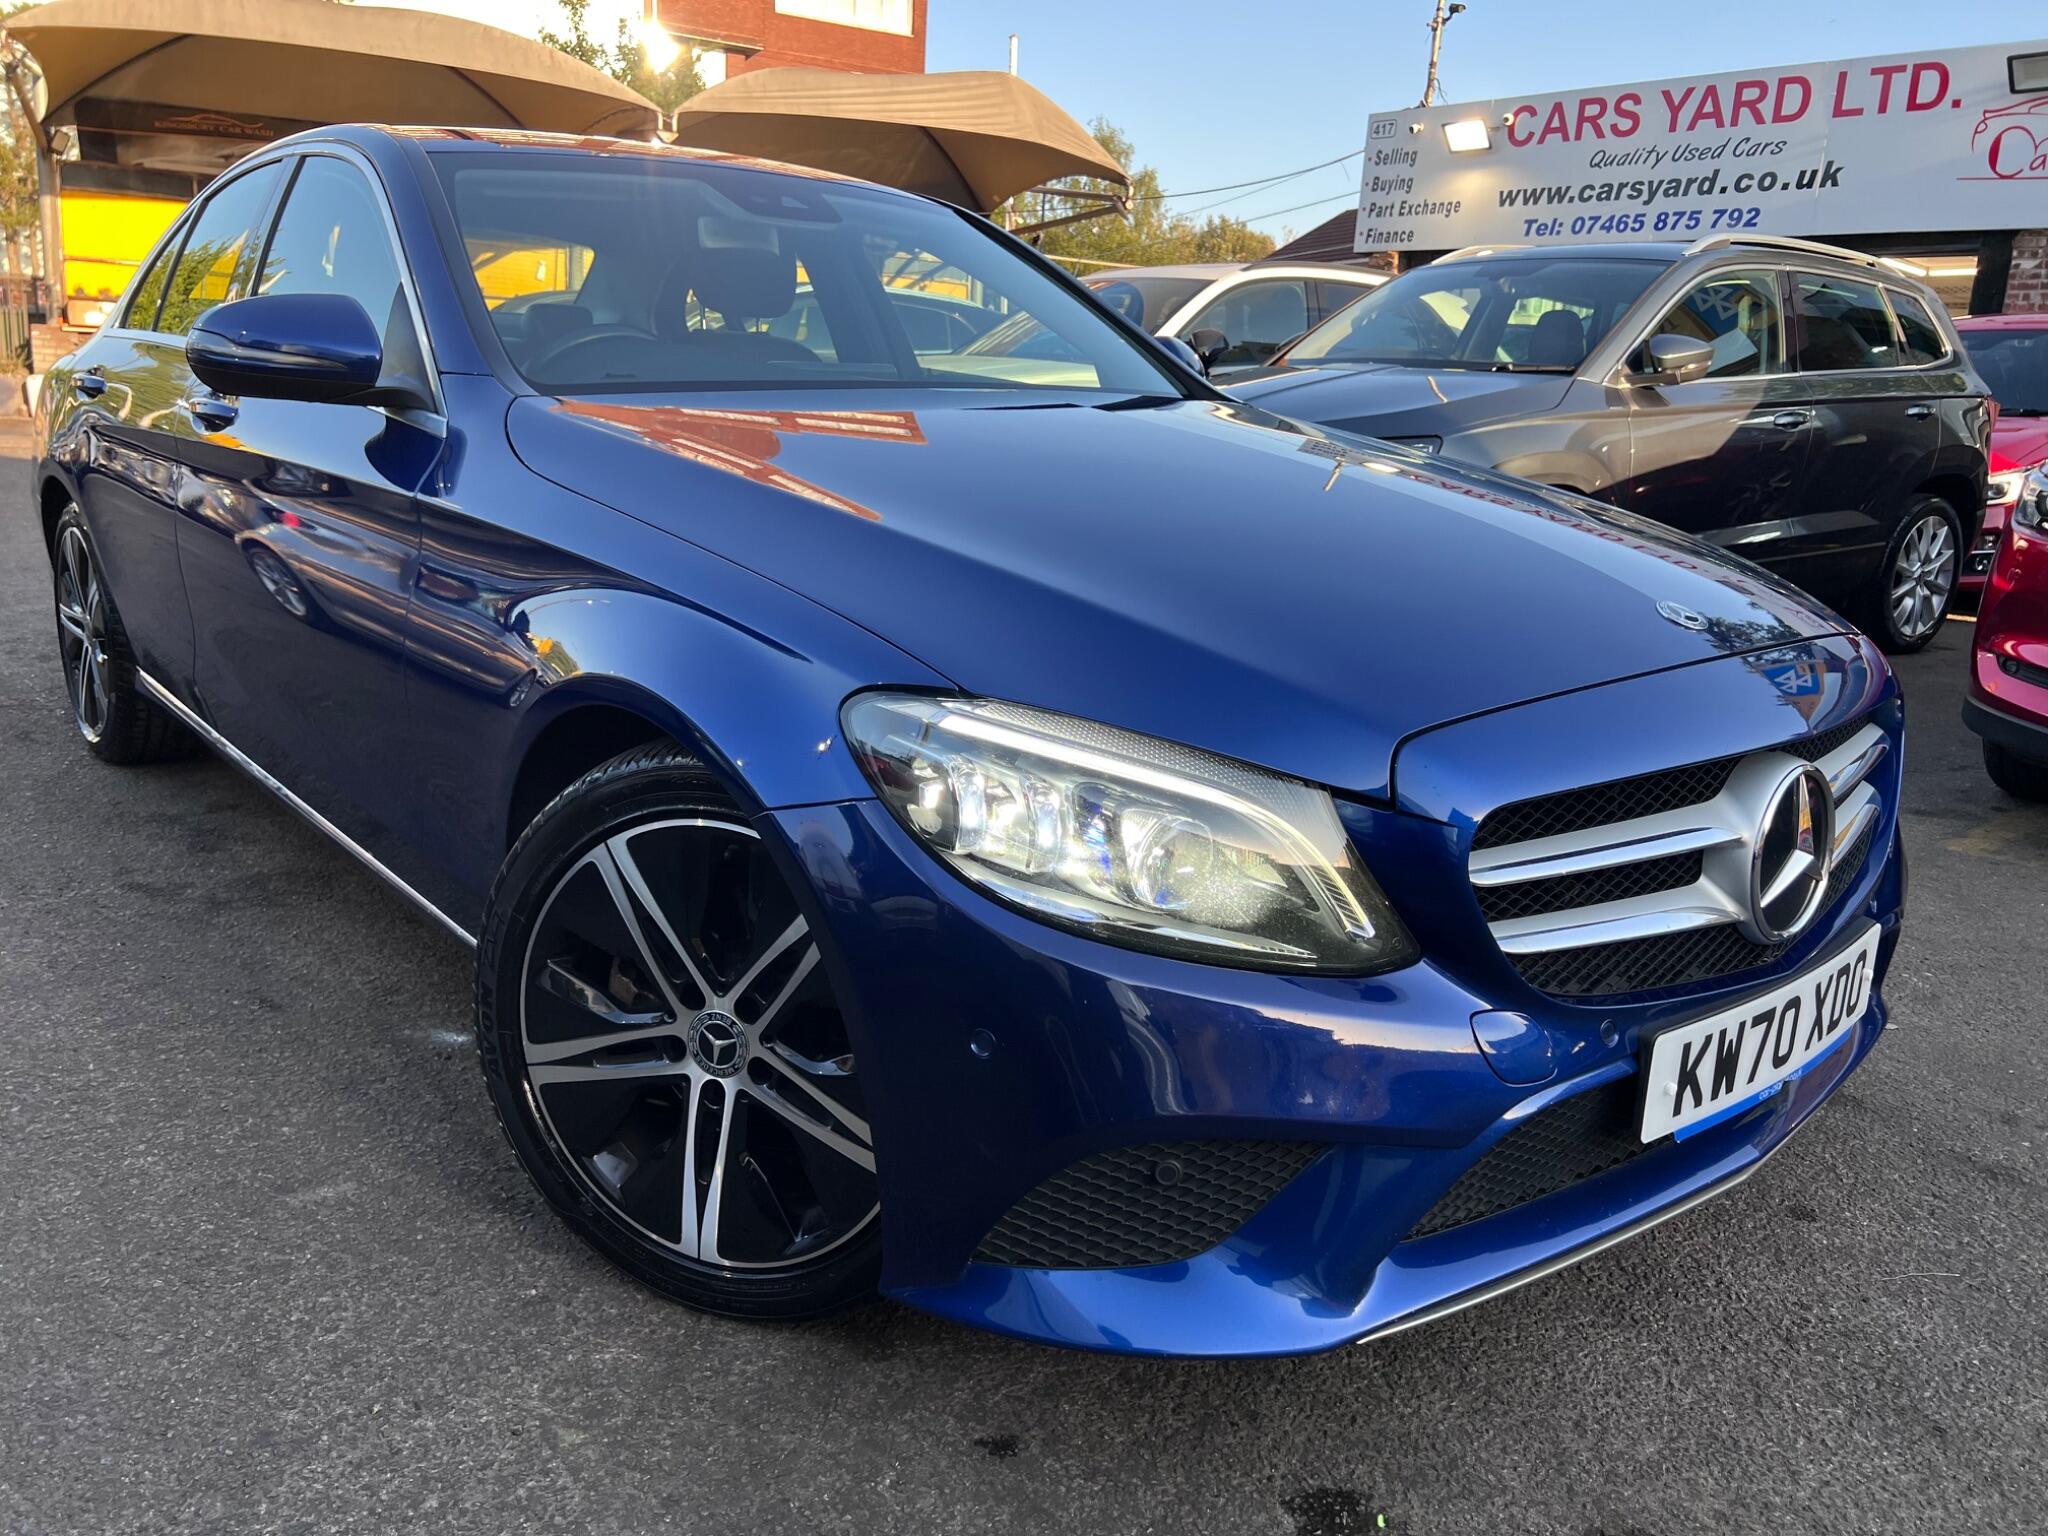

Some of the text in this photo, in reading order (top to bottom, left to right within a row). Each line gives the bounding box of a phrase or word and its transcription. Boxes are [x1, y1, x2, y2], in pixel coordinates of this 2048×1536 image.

[1507, 61, 1962, 148] CARS YARD LTD.
[218, 124, 242, 134] CAR
[243, 127, 275, 137] WASH
[1372, 121, 1395, 137] 417
[1374, 149, 1417, 167] Selling
[1589, 136, 1787, 169] Quality Used Cars
[1371, 176, 1413, 194] Buying
[1498, 160, 1844, 207] www.carsyard.co.uk
[1368, 199, 1461, 219] Part Exchange
[1523, 207, 1761, 238] Tel: 07465 875 792
[1365, 228, 1415, 244] Finance
[1672, 949, 1868, 1118] KW70 XDO
